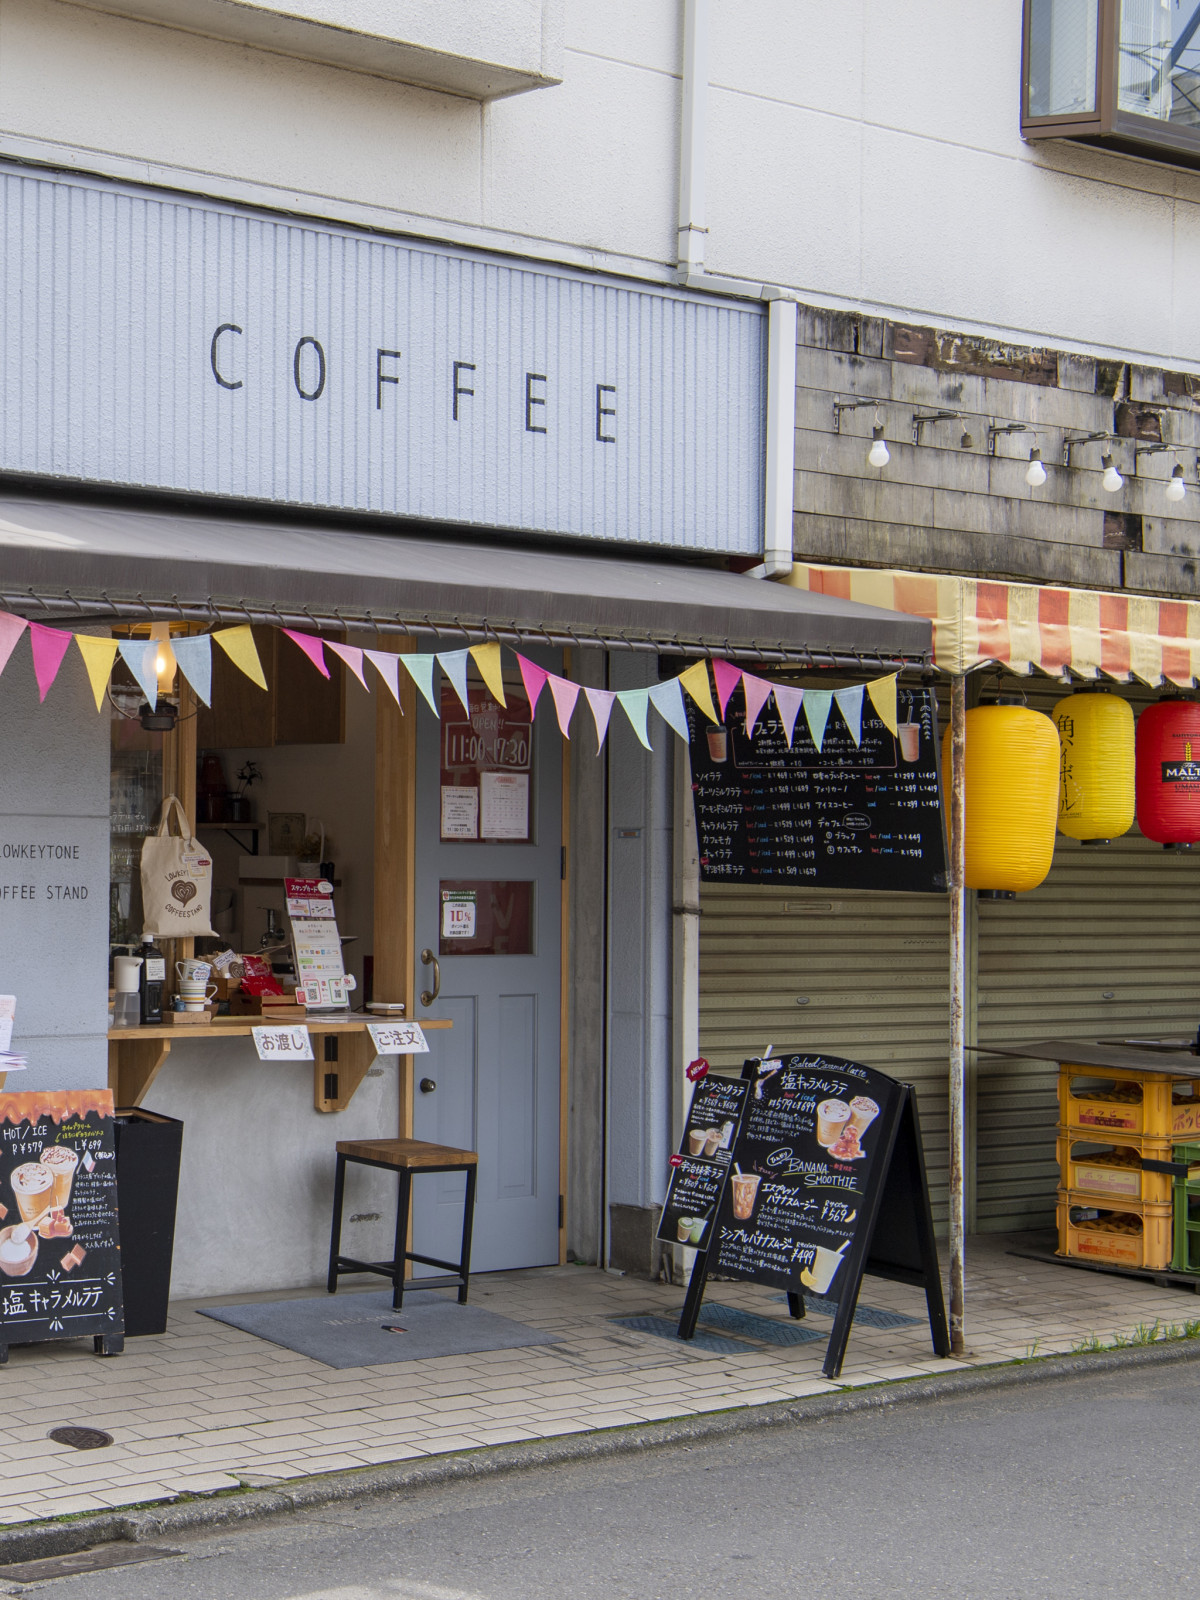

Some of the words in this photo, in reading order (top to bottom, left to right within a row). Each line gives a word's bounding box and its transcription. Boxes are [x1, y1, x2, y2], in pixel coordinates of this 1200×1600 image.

[210, 323, 615, 443] COFFEE
[452, 735, 527, 764] 11:00-17:30
[815, 801, 853, 809] アイスコーヒー
[701, 820, 739, 831] キャラメルラテ
[703, 836, 732, 845] カフェモカ
[835, 831, 856, 840] ブラック
[704, 849, 733, 859] チャイラテ
[46, 885, 89, 900] STAND
[450, 910, 471, 922] 10%
[261, 1033, 304, 1051] お渡し
[377, 1029, 420, 1046] ご注文
[788, 1056, 820, 1069] Salted
[698, 1078, 745, 1096] オーツミルクラテ
[780, 1072, 848, 1095] 塩キャラメルラテ
[681, 1160, 724, 1179] 宇治抹茶ラテ
[783, 1157, 829, 1174] BANANA
[761, 1183, 800, 1196] エスプレッソ
[804, 1174, 858, 1191] SMOOTHIE
[766, 1192, 818, 1210] バナナスムージー
[821, 1206, 848, 1222] ¥569
[719, 1226, 793, 1250] シンプルバナナスムージー
[791, 1248, 815, 1265] ¥499
[2, 1287, 103, 1315] 塩キャラメルラテ
